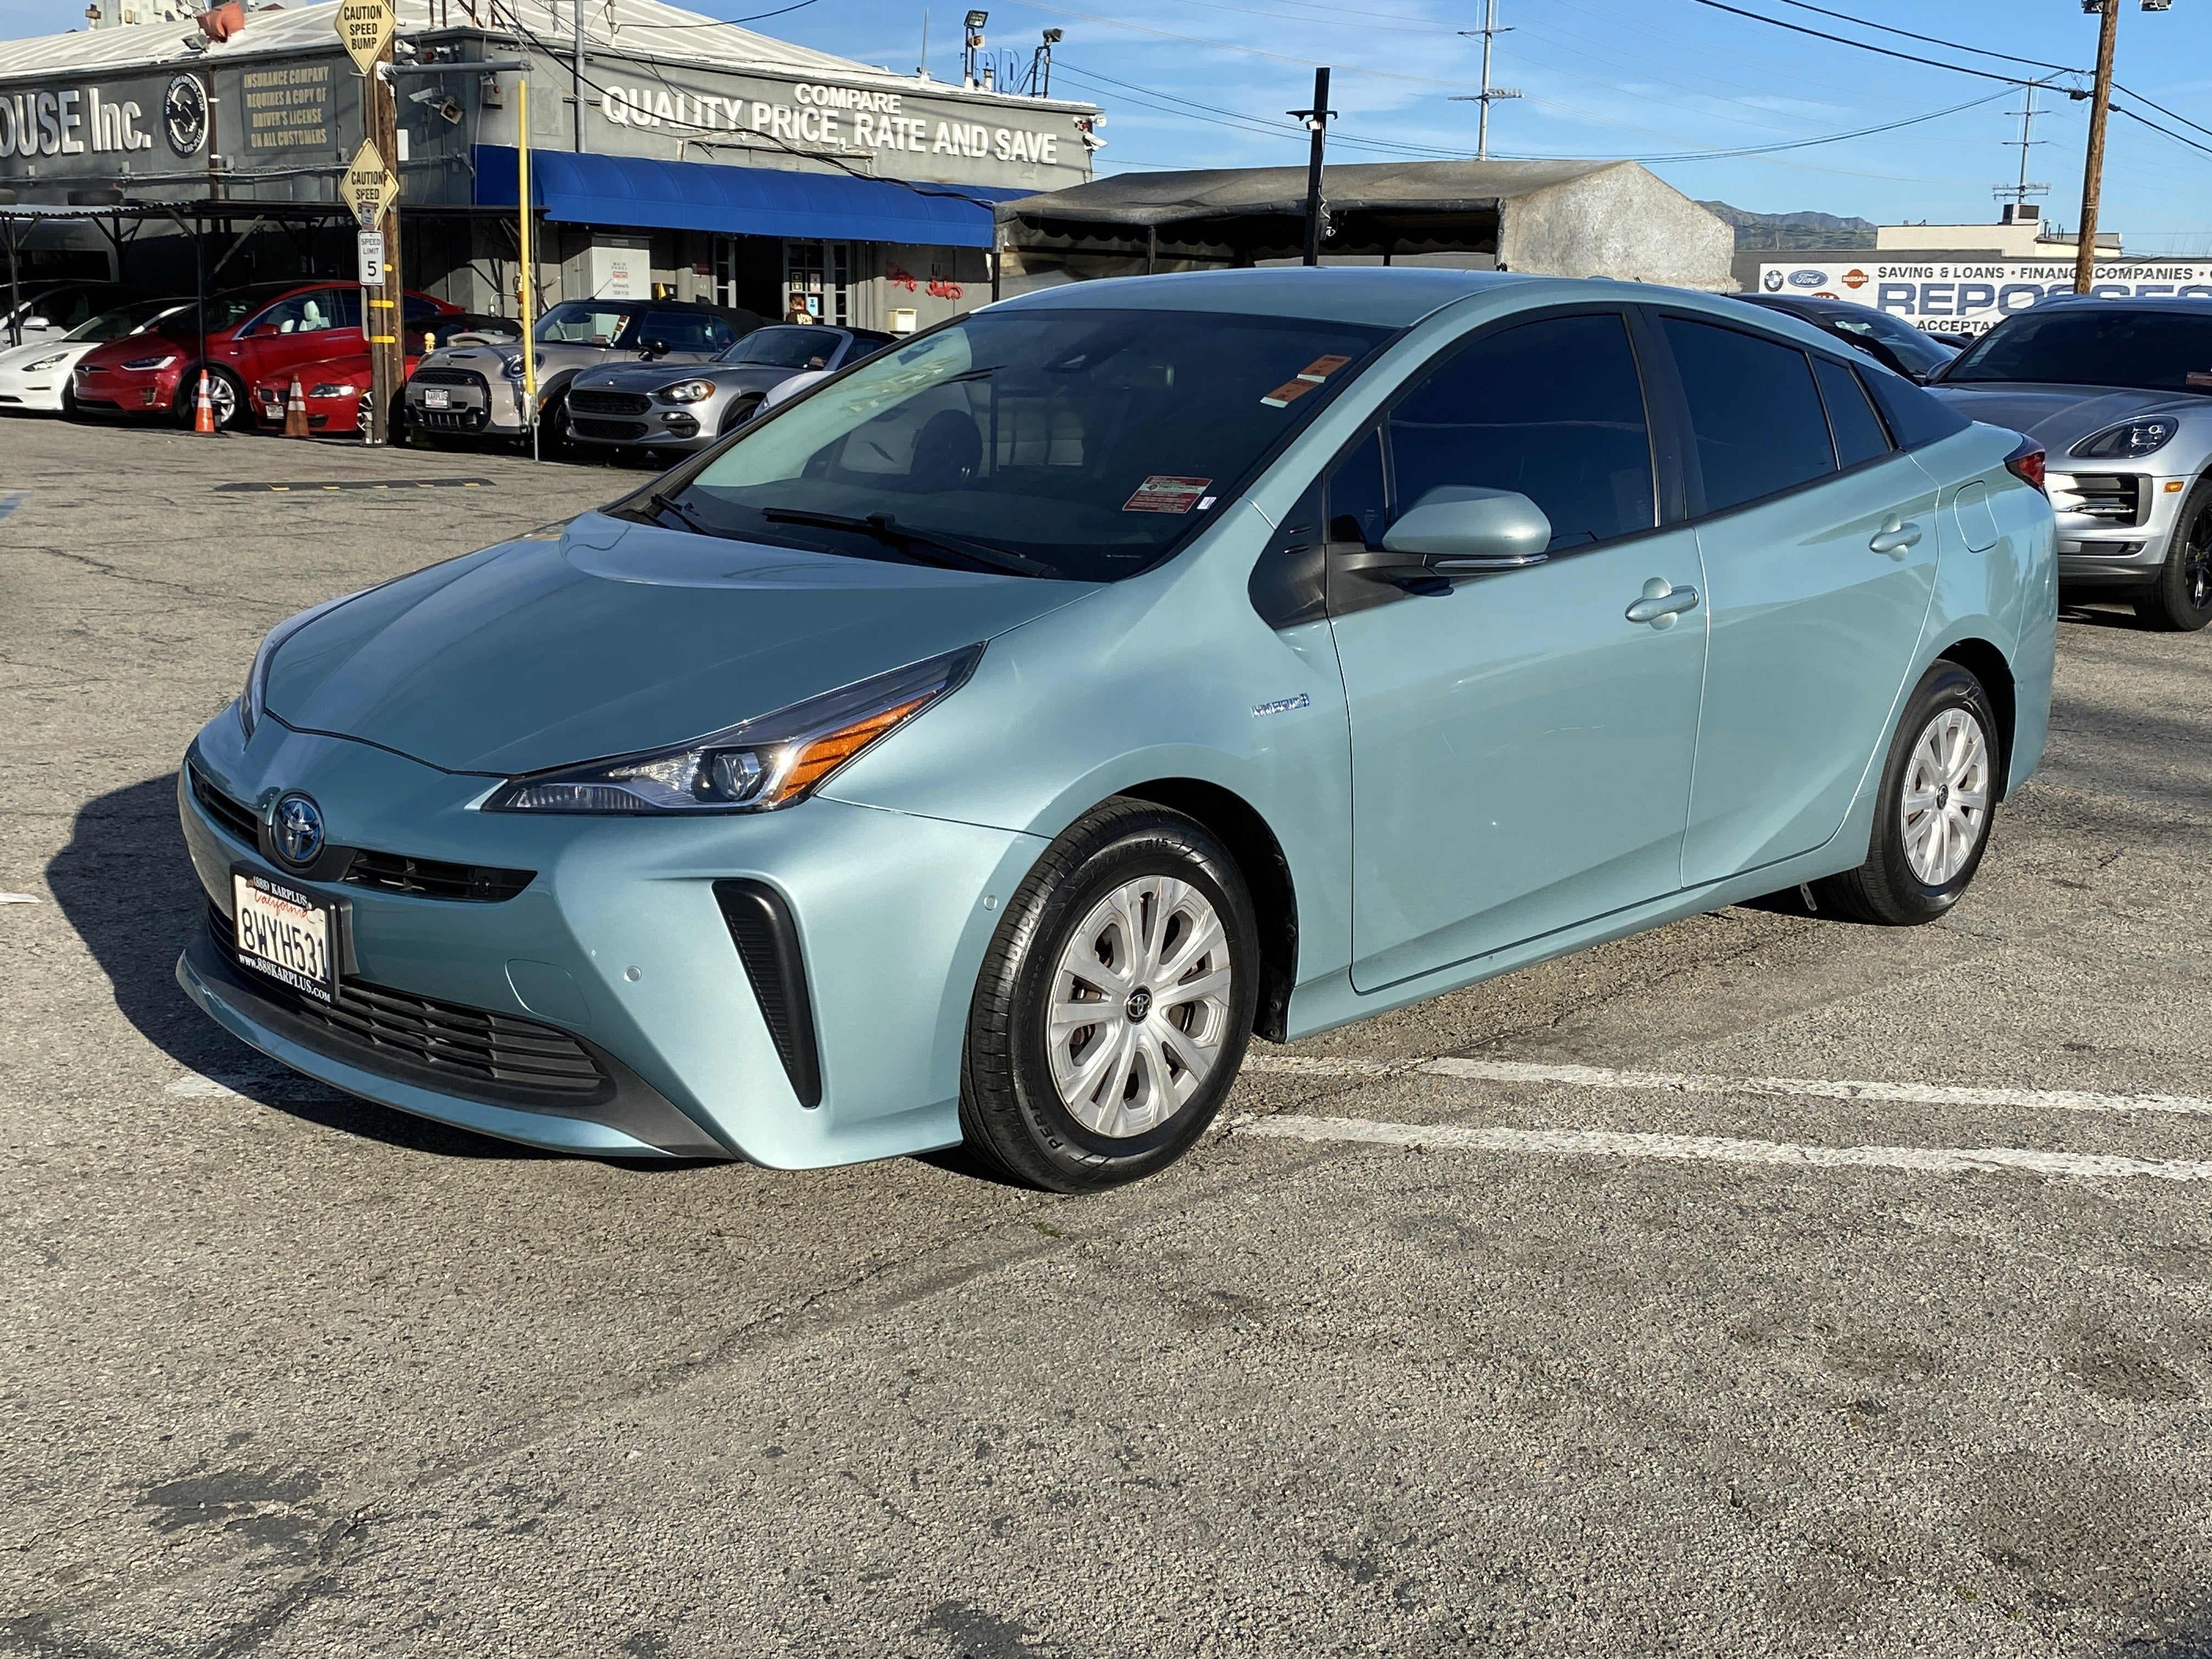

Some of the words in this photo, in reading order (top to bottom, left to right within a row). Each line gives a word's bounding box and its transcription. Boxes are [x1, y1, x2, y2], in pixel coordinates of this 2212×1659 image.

[344, 5, 382, 20] CAUTION
[349, 23, 377, 36] SPEED
[351, 38, 377, 50] BUMP
[244, 70, 287, 88] INSURANCE
[289, 66, 329, 84] COMPANY
[247, 91, 284, 109] REQUIRES
[285, 91, 291, 105] A
[292, 88, 315, 104] COPY
[316, 87, 326, 102] OF
[794, 82, 902, 115] COMPARE
[89, 87, 151, 151] Inc.
[252, 111, 288, 127] DRIVER'S
[290, 108, 322, 125] LICENSE
[601, 85, 744, 132] QUALITY
[752, 101, 847, 152] PRICE,
[854, 112, 927, 153] RATE
[933, 121, 988, 157] AND
[994, 128, 1058, 165] SAVE
[251, 133, 263, 148] ON
[263, 132, 277, 147] ALL
[278, 128, 327, 146] CUSTOMERS
[351, 171, 383, 185] CAUTION
[356, 188, 379, 200] SPEED
[357, 202, 379, 214] BP
[368, 261, 377, 276] 5
[1877, 267, 1933, 279] SAVING
[1939, 267, 1949, 279] &
[1953, 267, 2004, 279] LOANS
[2020, 267, 2076, 279] FINANC
[2095, 267, 2193, 280] COMPANIES
[1796, 273, 1819, 284] Ford
[1917, 320, 1998, 332] ACCEPTA
[253, 876, 270, 891] (888)
[270, 882, 308, 906] KARPLUS
[242, 907, 331, 985] 8WYH531
